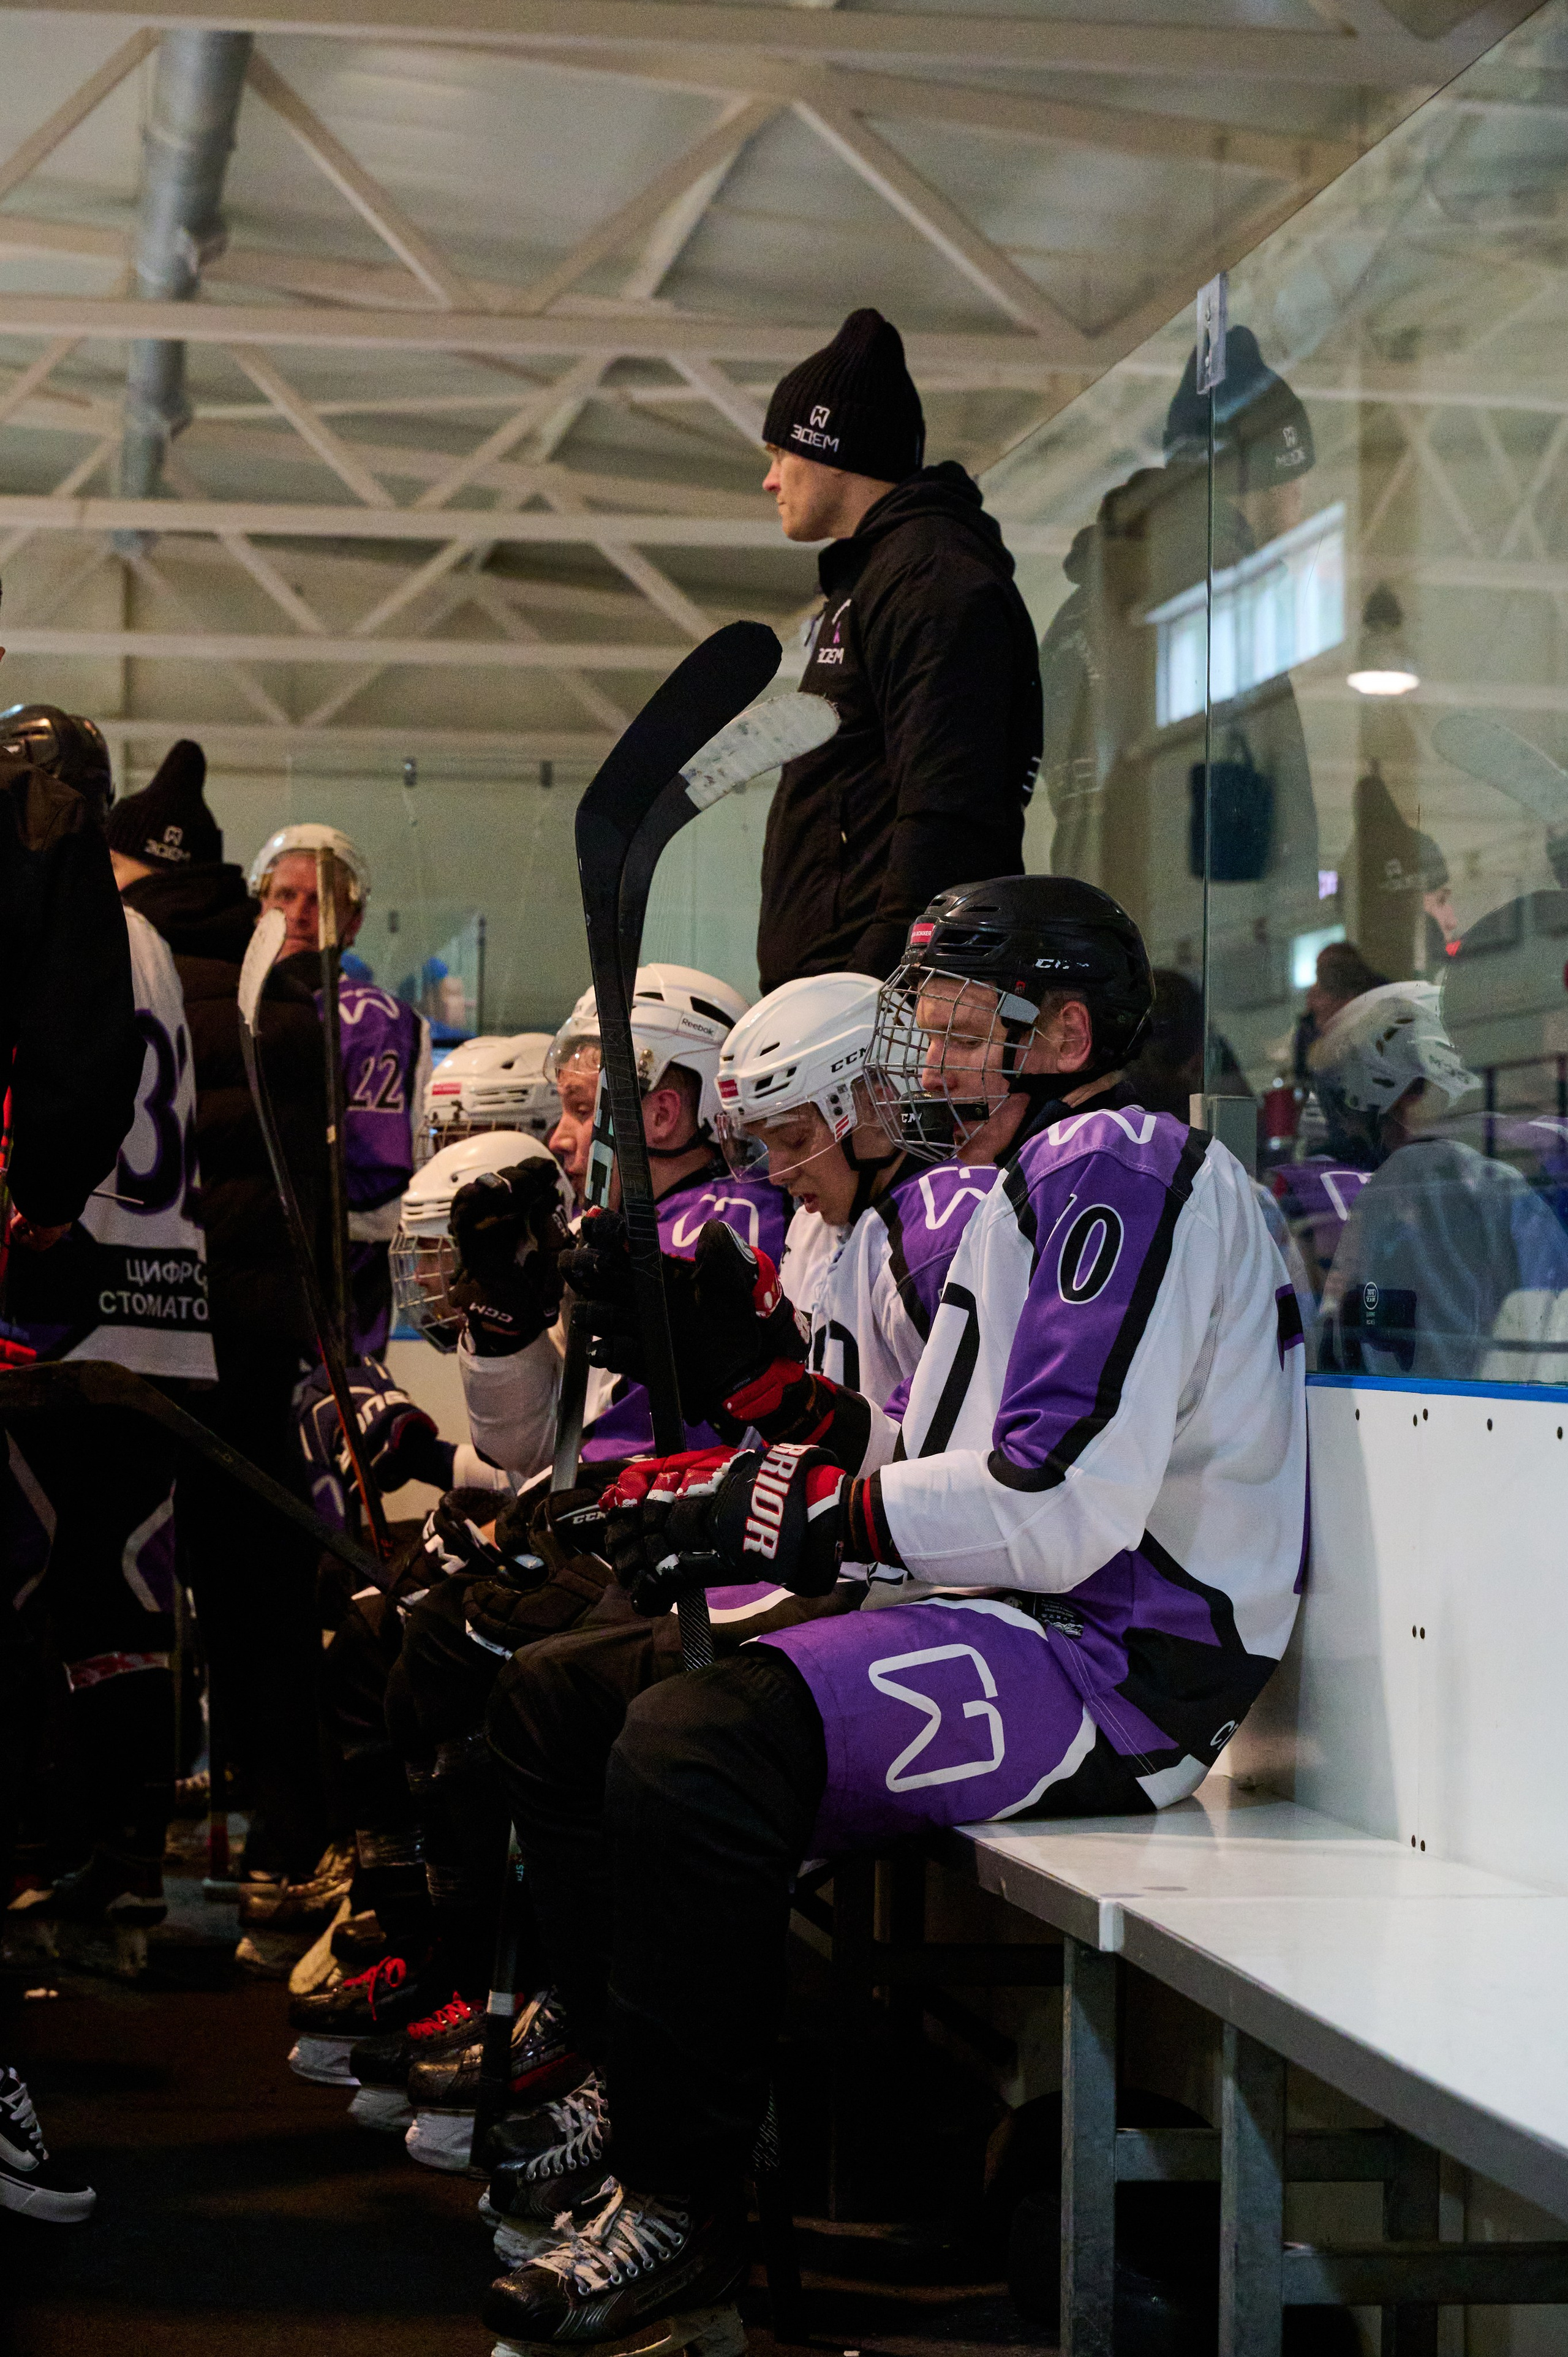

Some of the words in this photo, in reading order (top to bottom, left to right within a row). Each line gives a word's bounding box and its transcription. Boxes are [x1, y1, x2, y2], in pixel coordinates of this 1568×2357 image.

[682, 1017, 714, 1036] Reebok
[347, 1048, 405, 1114] 22
[99, 1289, 209, 1322] СТОМАТО
